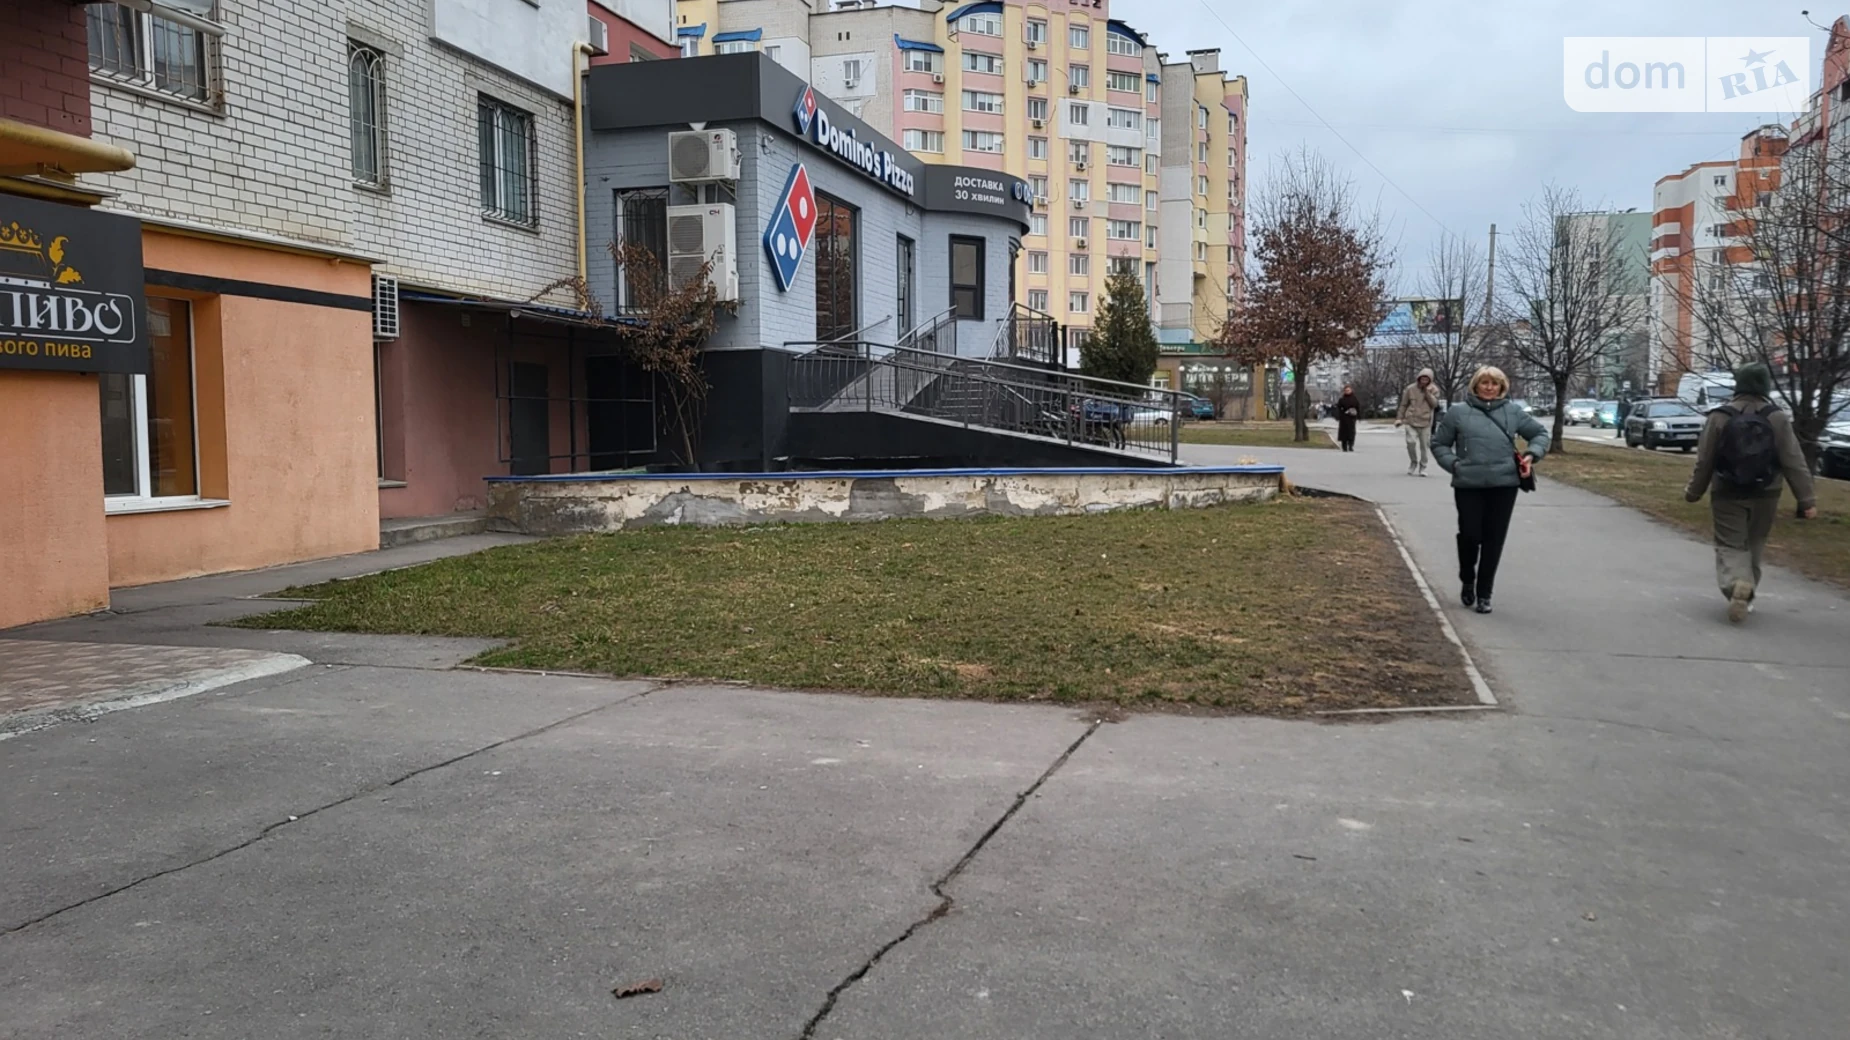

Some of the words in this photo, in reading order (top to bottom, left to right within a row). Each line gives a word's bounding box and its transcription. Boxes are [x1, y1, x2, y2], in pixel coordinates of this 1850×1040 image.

[817, 107, 881, 177] Domino's
[883, 151, 914, 197] Pizza
[954, 176, 1005, 192] ДОСТАВКА
[955, 190, 969, 200] 30
[0, 340, 39, 356] ого
[45, 342, 92, 358] пива
[1186, 372, 1249, 383] ШПАЕРИ
